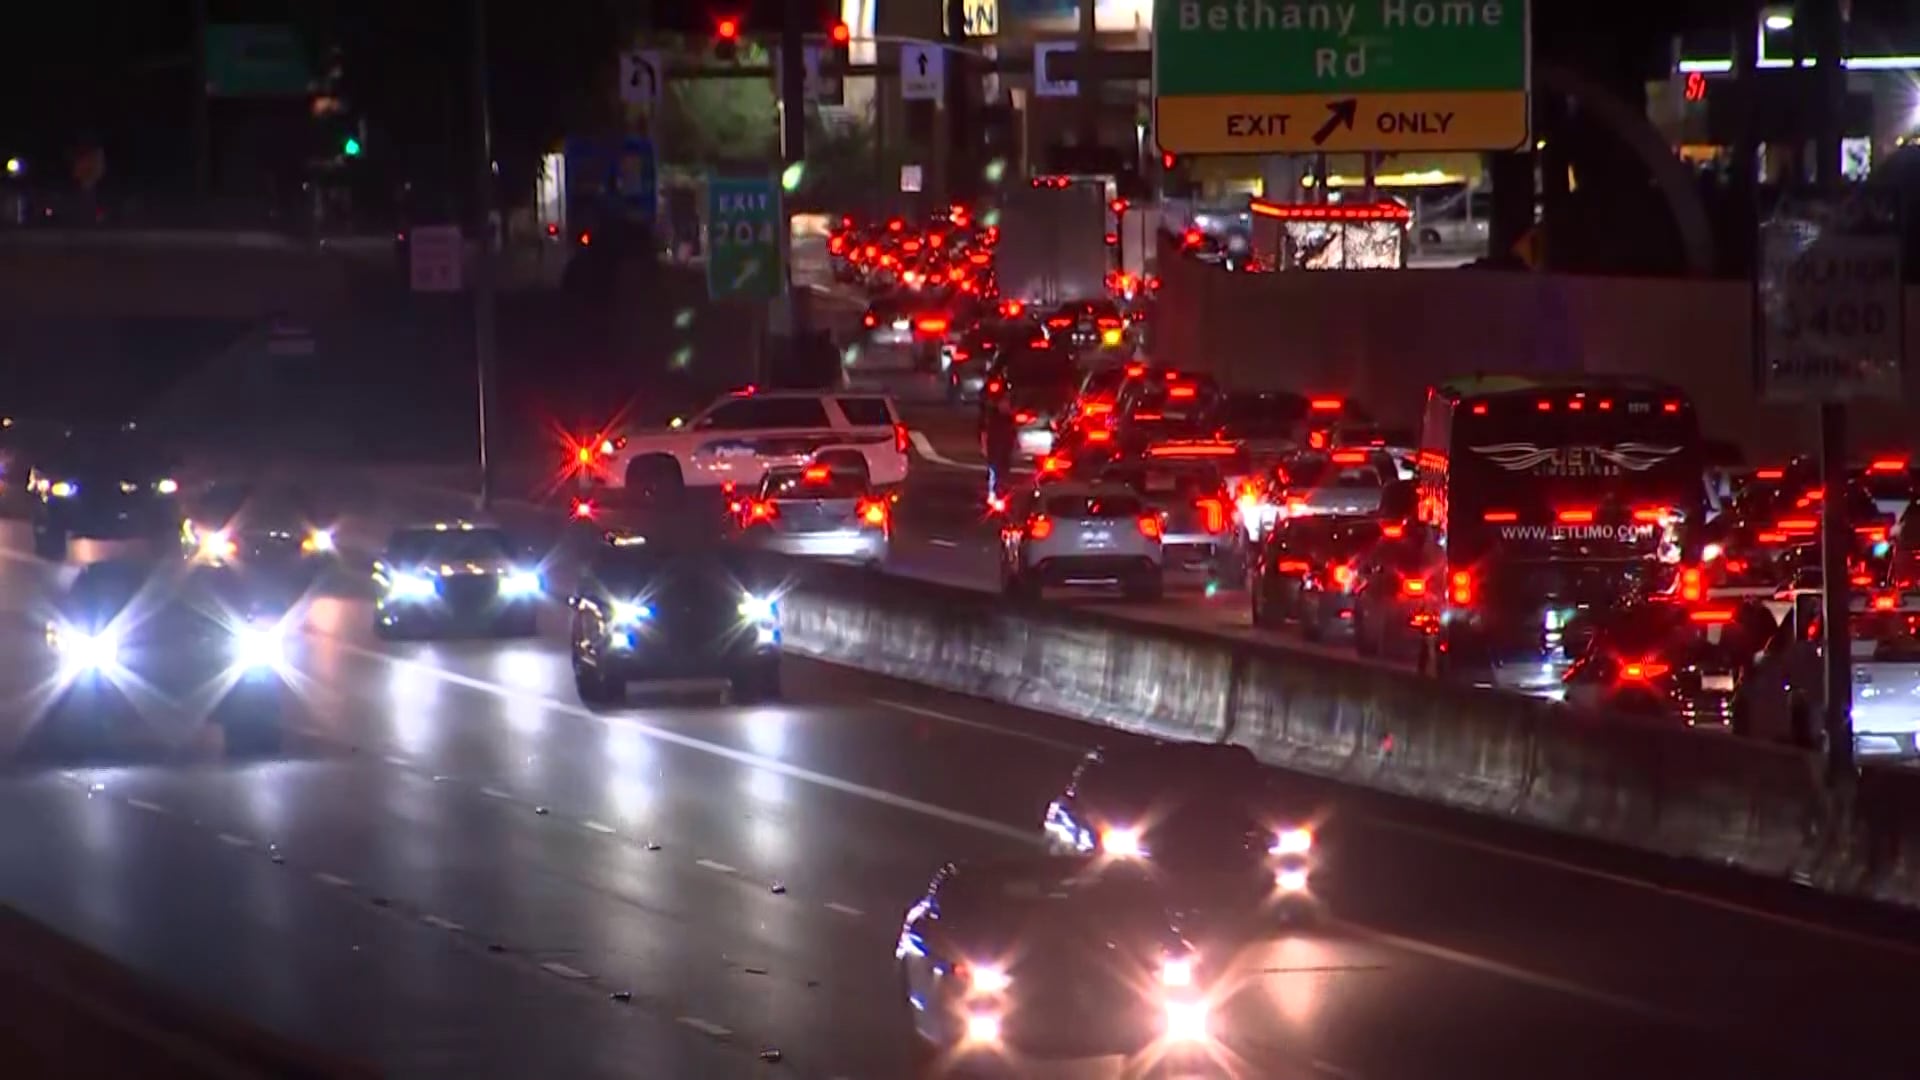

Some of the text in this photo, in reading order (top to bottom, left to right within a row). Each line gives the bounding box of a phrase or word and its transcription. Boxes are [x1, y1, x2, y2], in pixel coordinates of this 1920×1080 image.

[1179, 0, 1503, 37] Bethany Home
[1315, 42, 1367, 79] Rd
[1226, 111, 1455, 137] EXIT ONLY
[718, 192, 768, 213] EXIT
